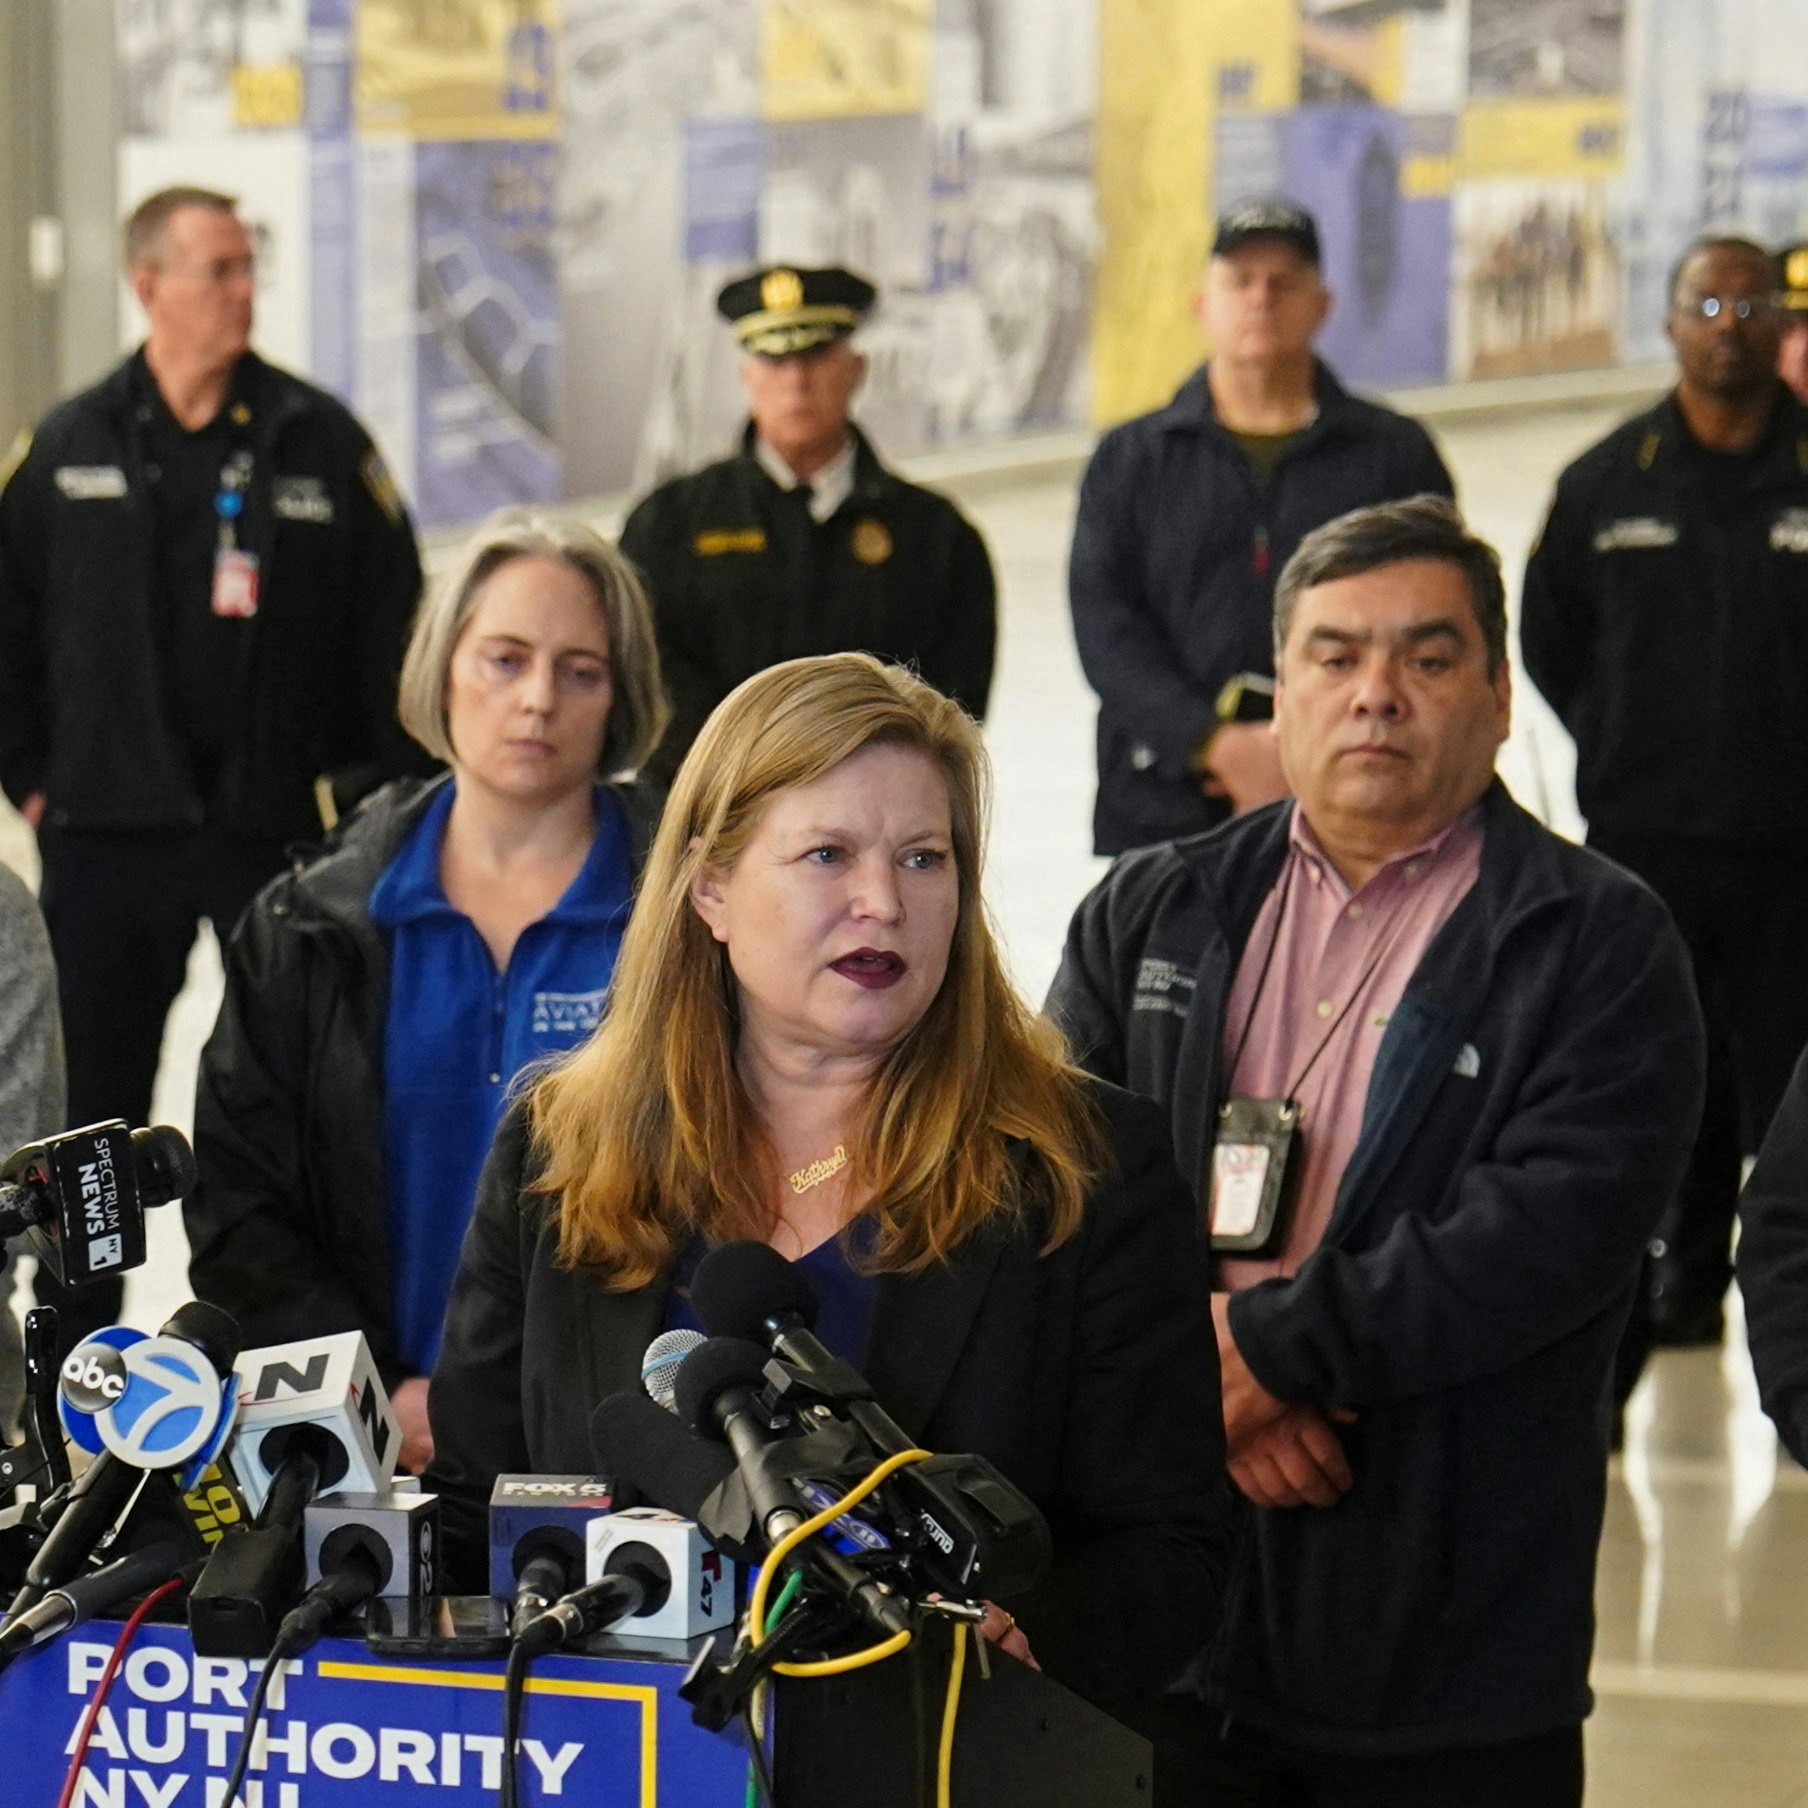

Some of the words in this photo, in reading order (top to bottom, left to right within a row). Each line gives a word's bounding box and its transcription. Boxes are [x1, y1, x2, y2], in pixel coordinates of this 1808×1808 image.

[78, 1161, 105, 1235] NEWS
[94, 1137, 120, 1230] SPECTRUM
[62, 1356, 125, 1399] abc
[254, 1353, 330, 1402] N
[502, 1482, 577, 1494] FOX
[68, 1641, 303, 1711] PORT
[65, 1704, 585, 1795] AUTHORITY
